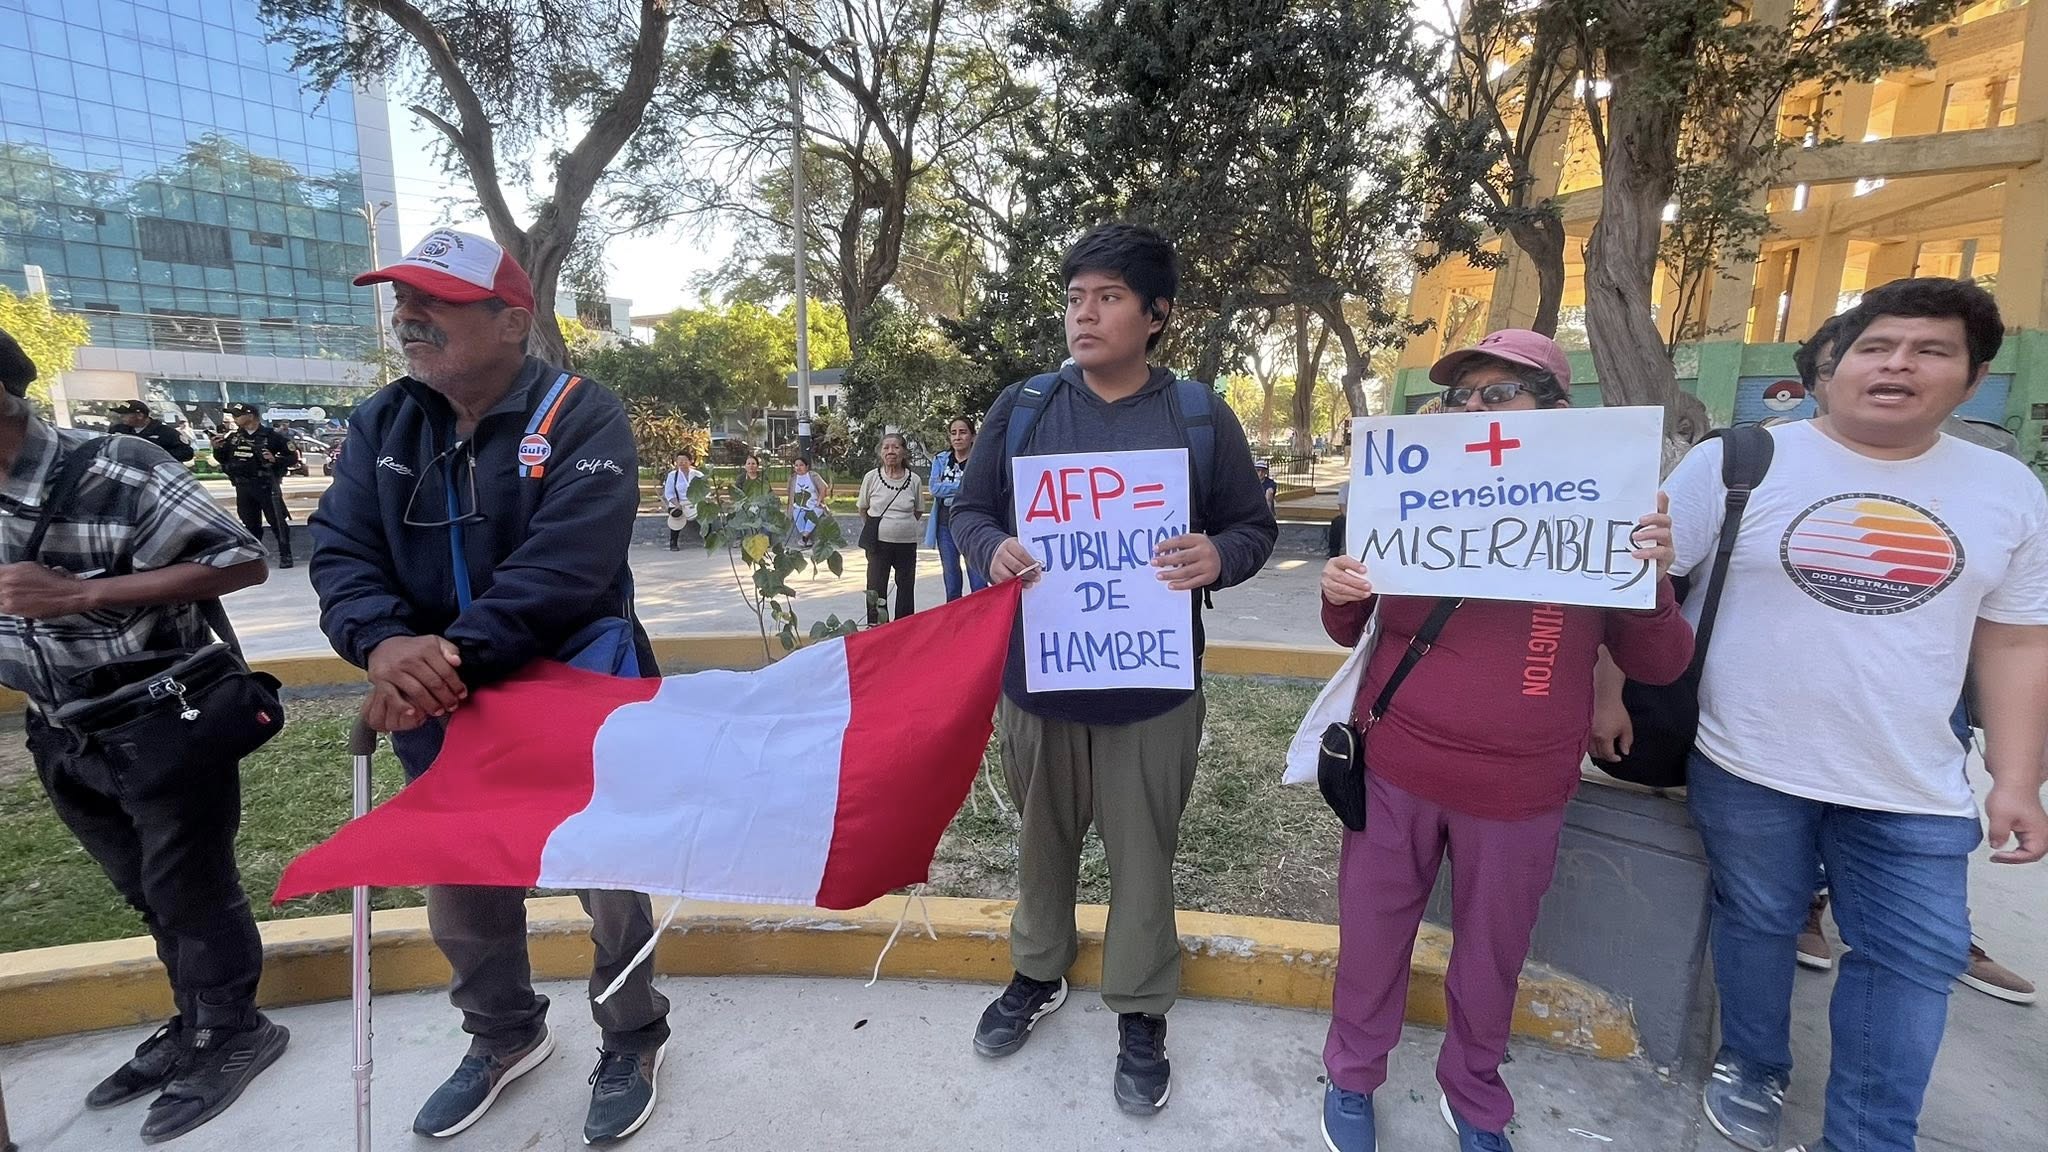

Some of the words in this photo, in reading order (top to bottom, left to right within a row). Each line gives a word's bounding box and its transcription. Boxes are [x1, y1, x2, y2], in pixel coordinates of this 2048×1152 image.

[520, 445, 547, 455] Gulf
[1364, 428, 1429, 477] No
[1465, 421, 1521, 467] +
[1025, 466, 1126, 524] AFP
[1132, 483, 1165, 509] =
[1399, 477, 1601, 522] pensiones
[1360, 516, 1651, 592] MISERABLES
[1074, 578, 1130, 613] DE
[1839, 576, 1910, 593] AUSTRALIA
[1040, 629, 1180, 674] HAMBRE
